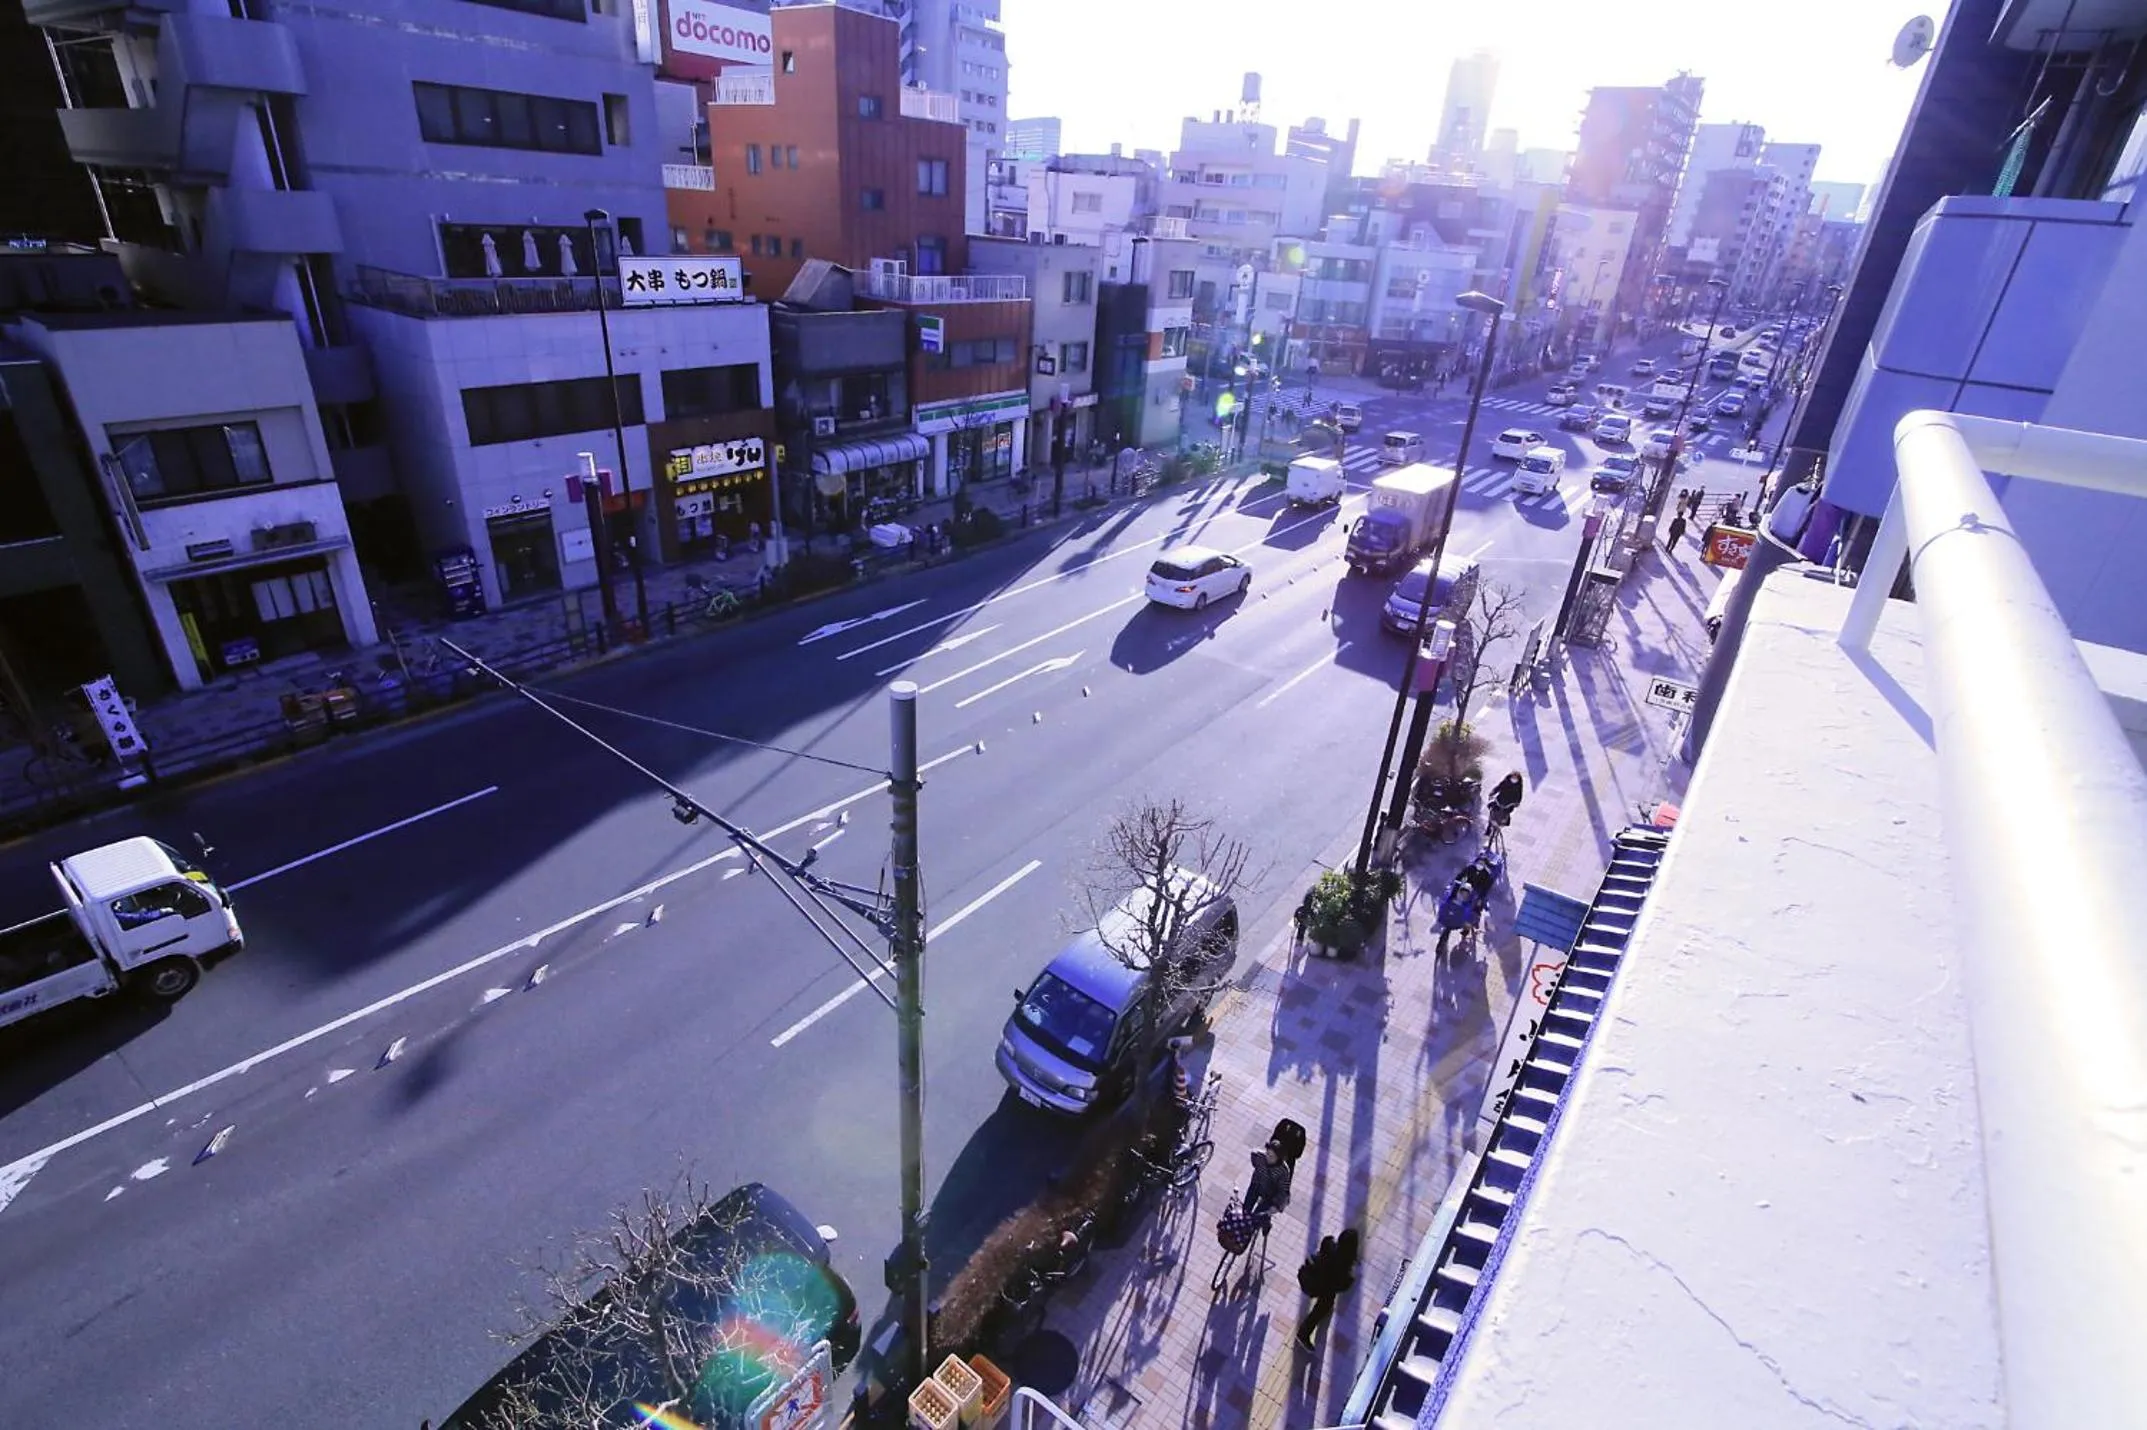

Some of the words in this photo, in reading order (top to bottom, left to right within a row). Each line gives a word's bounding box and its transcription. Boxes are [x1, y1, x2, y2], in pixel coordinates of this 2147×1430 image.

[676, 11, 771, 53] docomo
[626, 268, 665, 292] 大串
[674, 268, 728, 290] もつ鍋
[487, 500, 548, 516] コインランドリー
